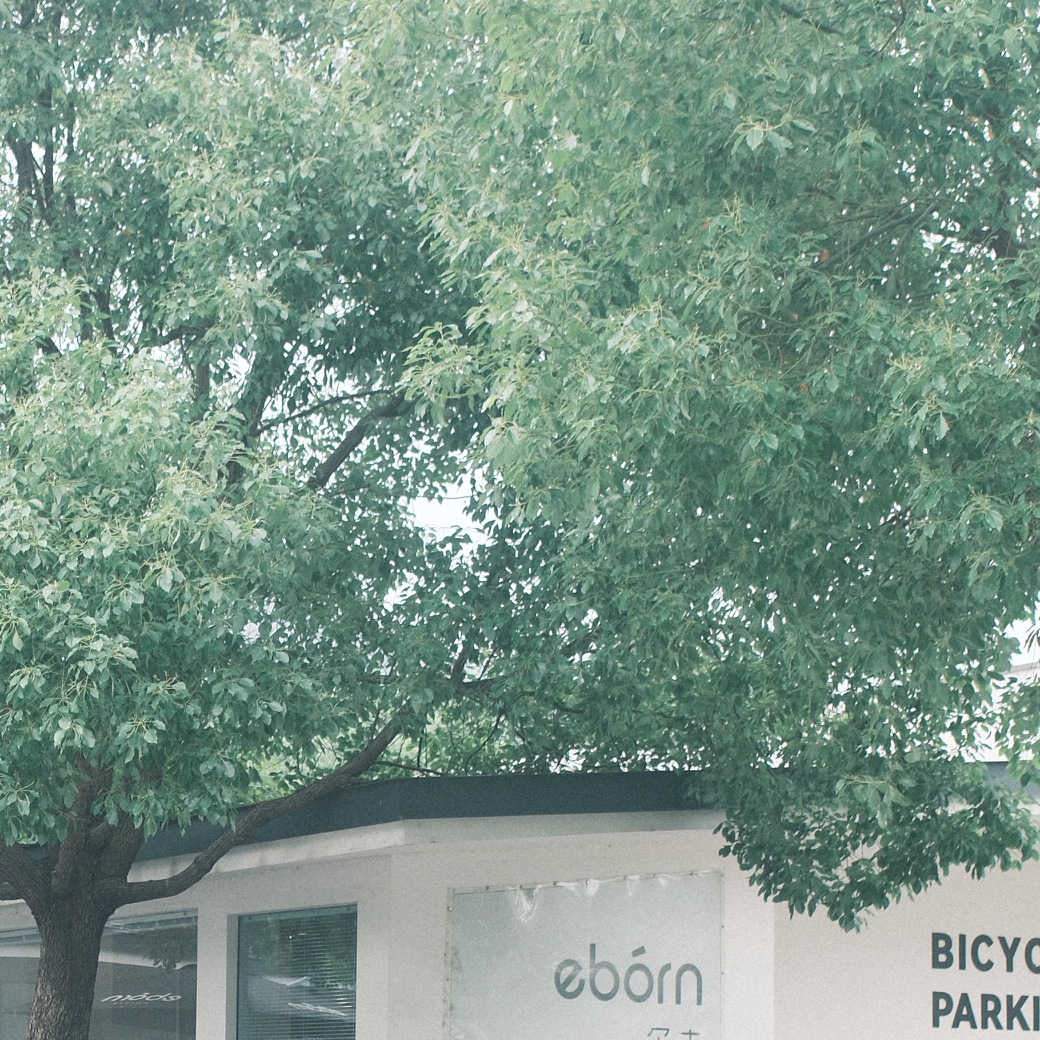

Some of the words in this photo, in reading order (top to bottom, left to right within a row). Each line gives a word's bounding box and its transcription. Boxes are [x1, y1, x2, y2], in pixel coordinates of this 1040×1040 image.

[931, 932, 1040, 974] BICYC
[554, 943, 703, 1006] ebórn
[932, 991, 1040, 1031] PARKI
